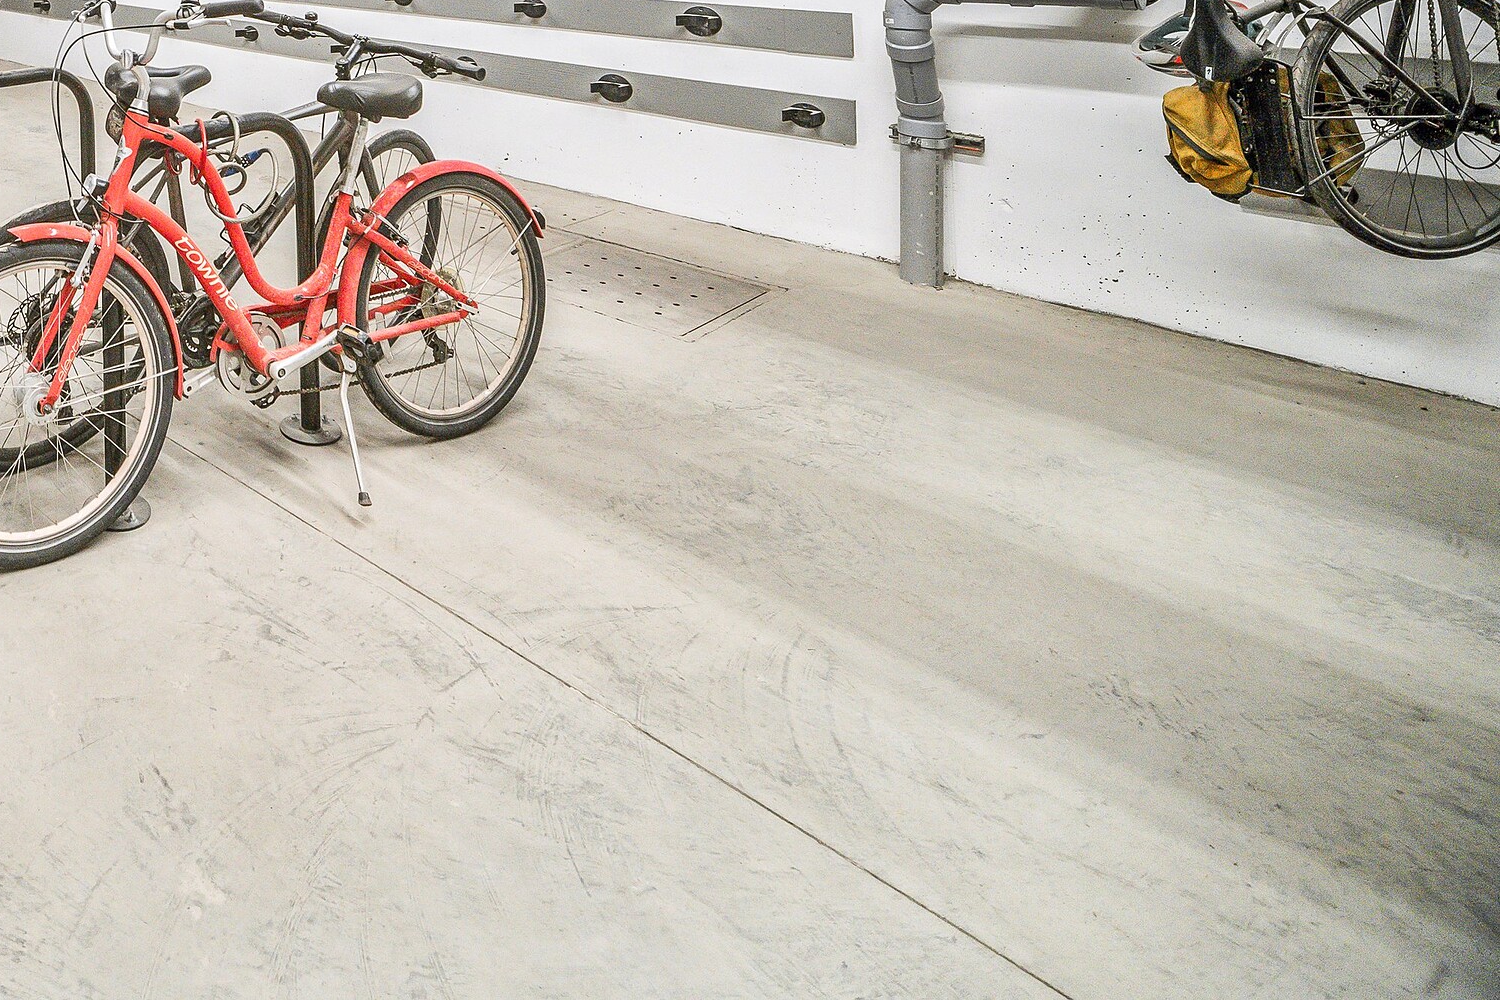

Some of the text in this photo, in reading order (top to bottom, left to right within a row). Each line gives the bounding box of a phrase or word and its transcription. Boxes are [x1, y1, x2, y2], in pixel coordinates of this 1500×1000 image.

[174, 236, 239, 311] townie
[407, 260, 446, 285] electra
[58, 323, 88, 382] electra
